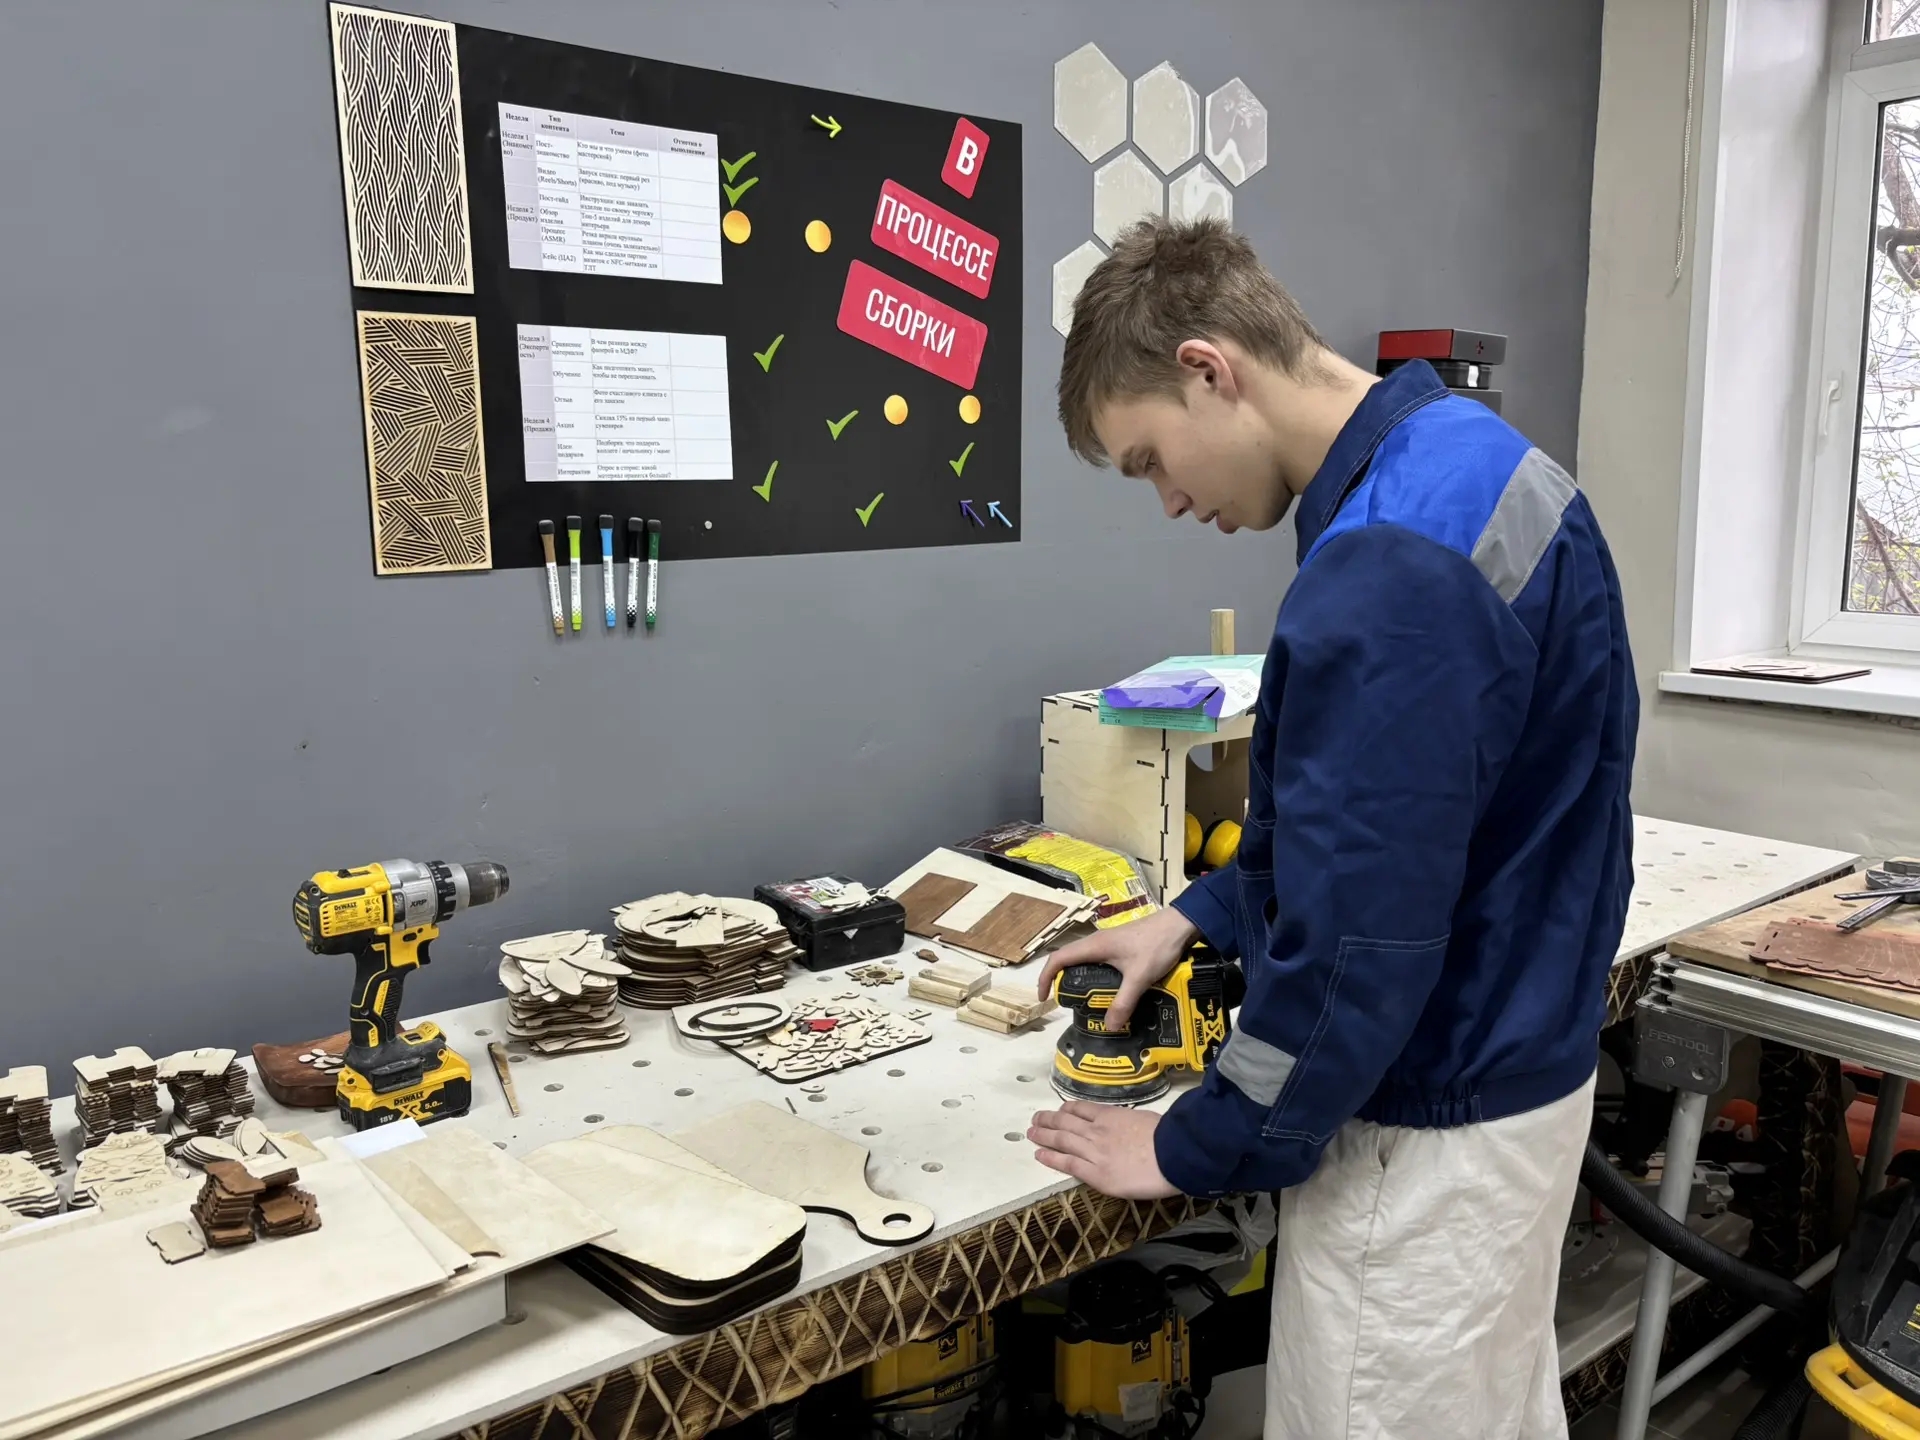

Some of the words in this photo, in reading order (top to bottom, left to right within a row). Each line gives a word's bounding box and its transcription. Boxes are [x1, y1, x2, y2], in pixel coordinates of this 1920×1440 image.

[506, 113, 529, 122] Неделя
[548, 115, 561, 123] Тип
[541, 124, 569, 132] контента
[610, 128, 625, 136] Тема
[502, 131, 524, 140] Неделя
[502, 140, 533, 150] (Знакомст
[536, 140, 553, 148] Пост-
[955, 136, 978, 176] В
[537, 167, 556, 175] Видео
[579, 169, 597, 178] Запуск
[620, 174, 640, 182] первый
[507, 204, 529, 213] Неделя
[540, 208, 558, 217] Обзор
[507, 213, 538, 223] (Продукт)
[541, 226, 566, 235] Процесс
[876, 193, 992, 281] ПРОЦЕССЕ
[542, 252, 557, 260] Кейс
[865, 288, 956, 358] СБОРКИ
[553, 370, 582, 379] Обучение
[1648, 1028, 1715, 1056] FESTOOL
[380, 1114, 394, 1124] 18V
